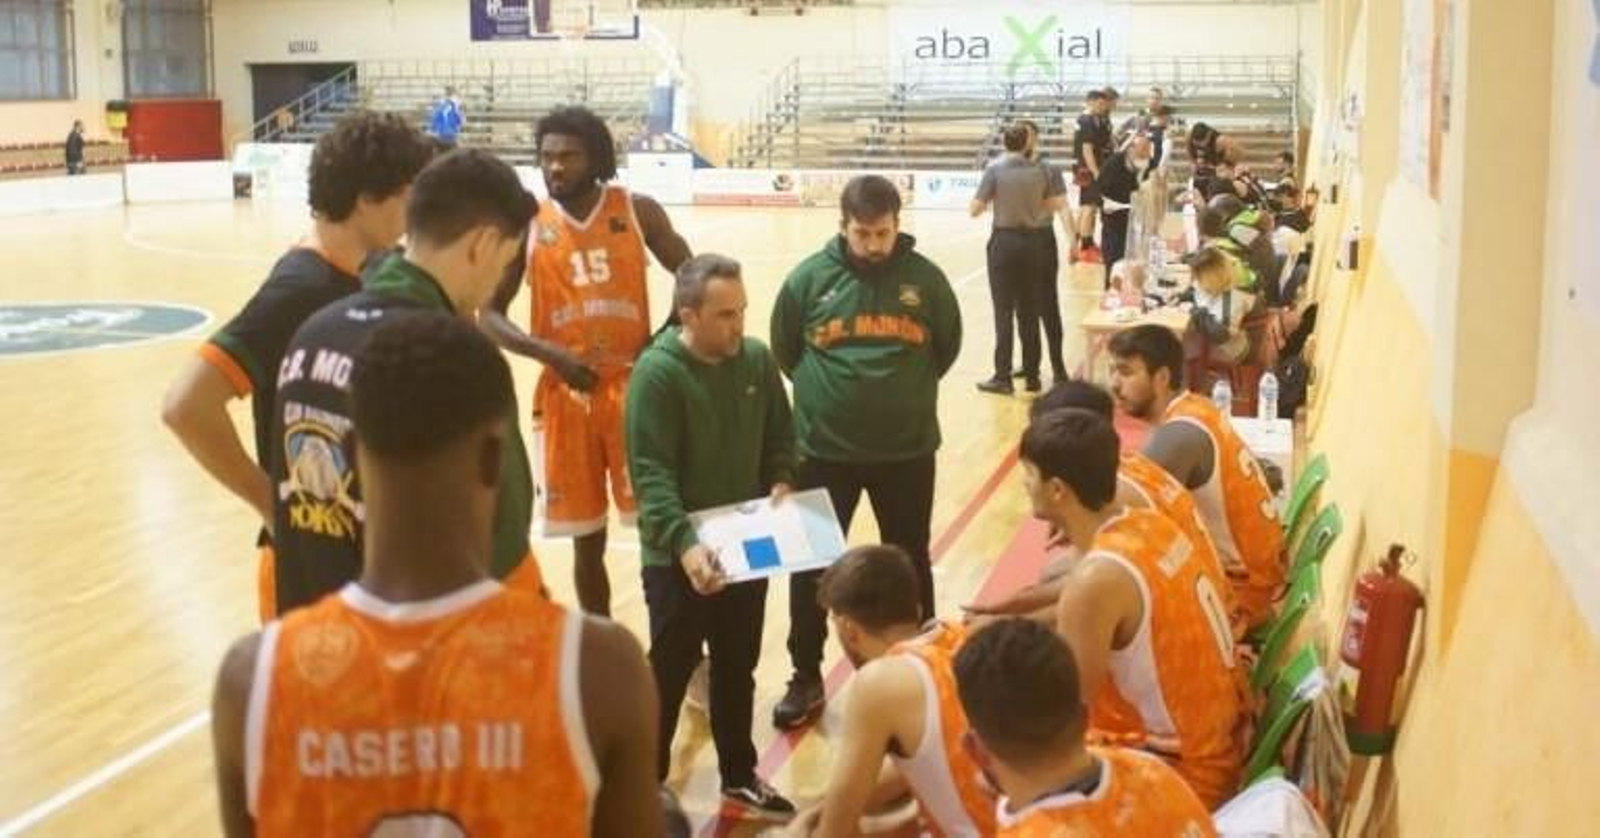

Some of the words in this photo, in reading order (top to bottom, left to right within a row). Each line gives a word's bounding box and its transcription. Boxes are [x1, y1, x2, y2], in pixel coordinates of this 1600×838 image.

[569, 249, 612, 287] 15
[311, 348, 354, 389] MO
[298, 726, 462, 778] CASERO
[477, 721, 523, 769] III
